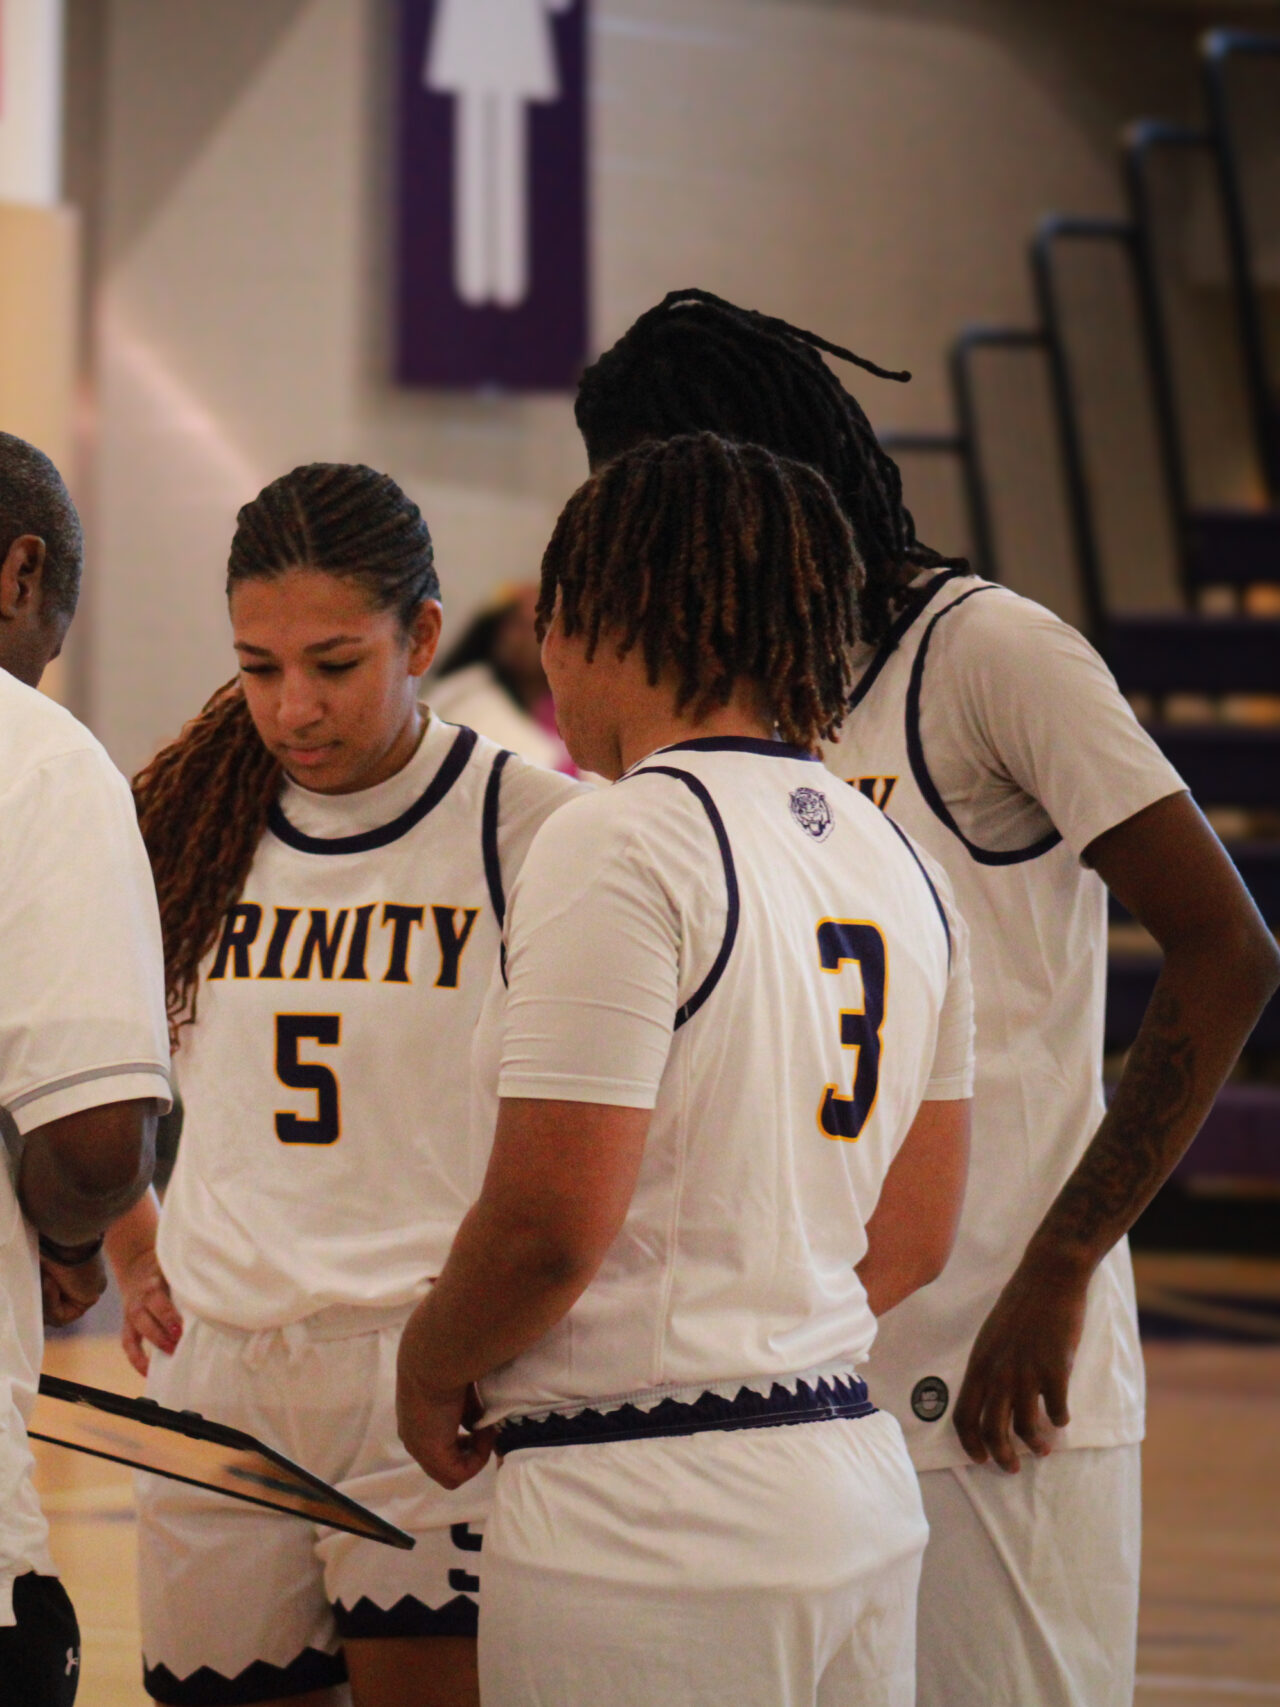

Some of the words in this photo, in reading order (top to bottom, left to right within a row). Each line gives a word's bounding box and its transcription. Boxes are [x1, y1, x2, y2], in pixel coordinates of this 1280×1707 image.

[207, 901, 480, 989] RINITY
[273, 1013, 342, 1146] 5
[815, 917, 889, 1143] 3
